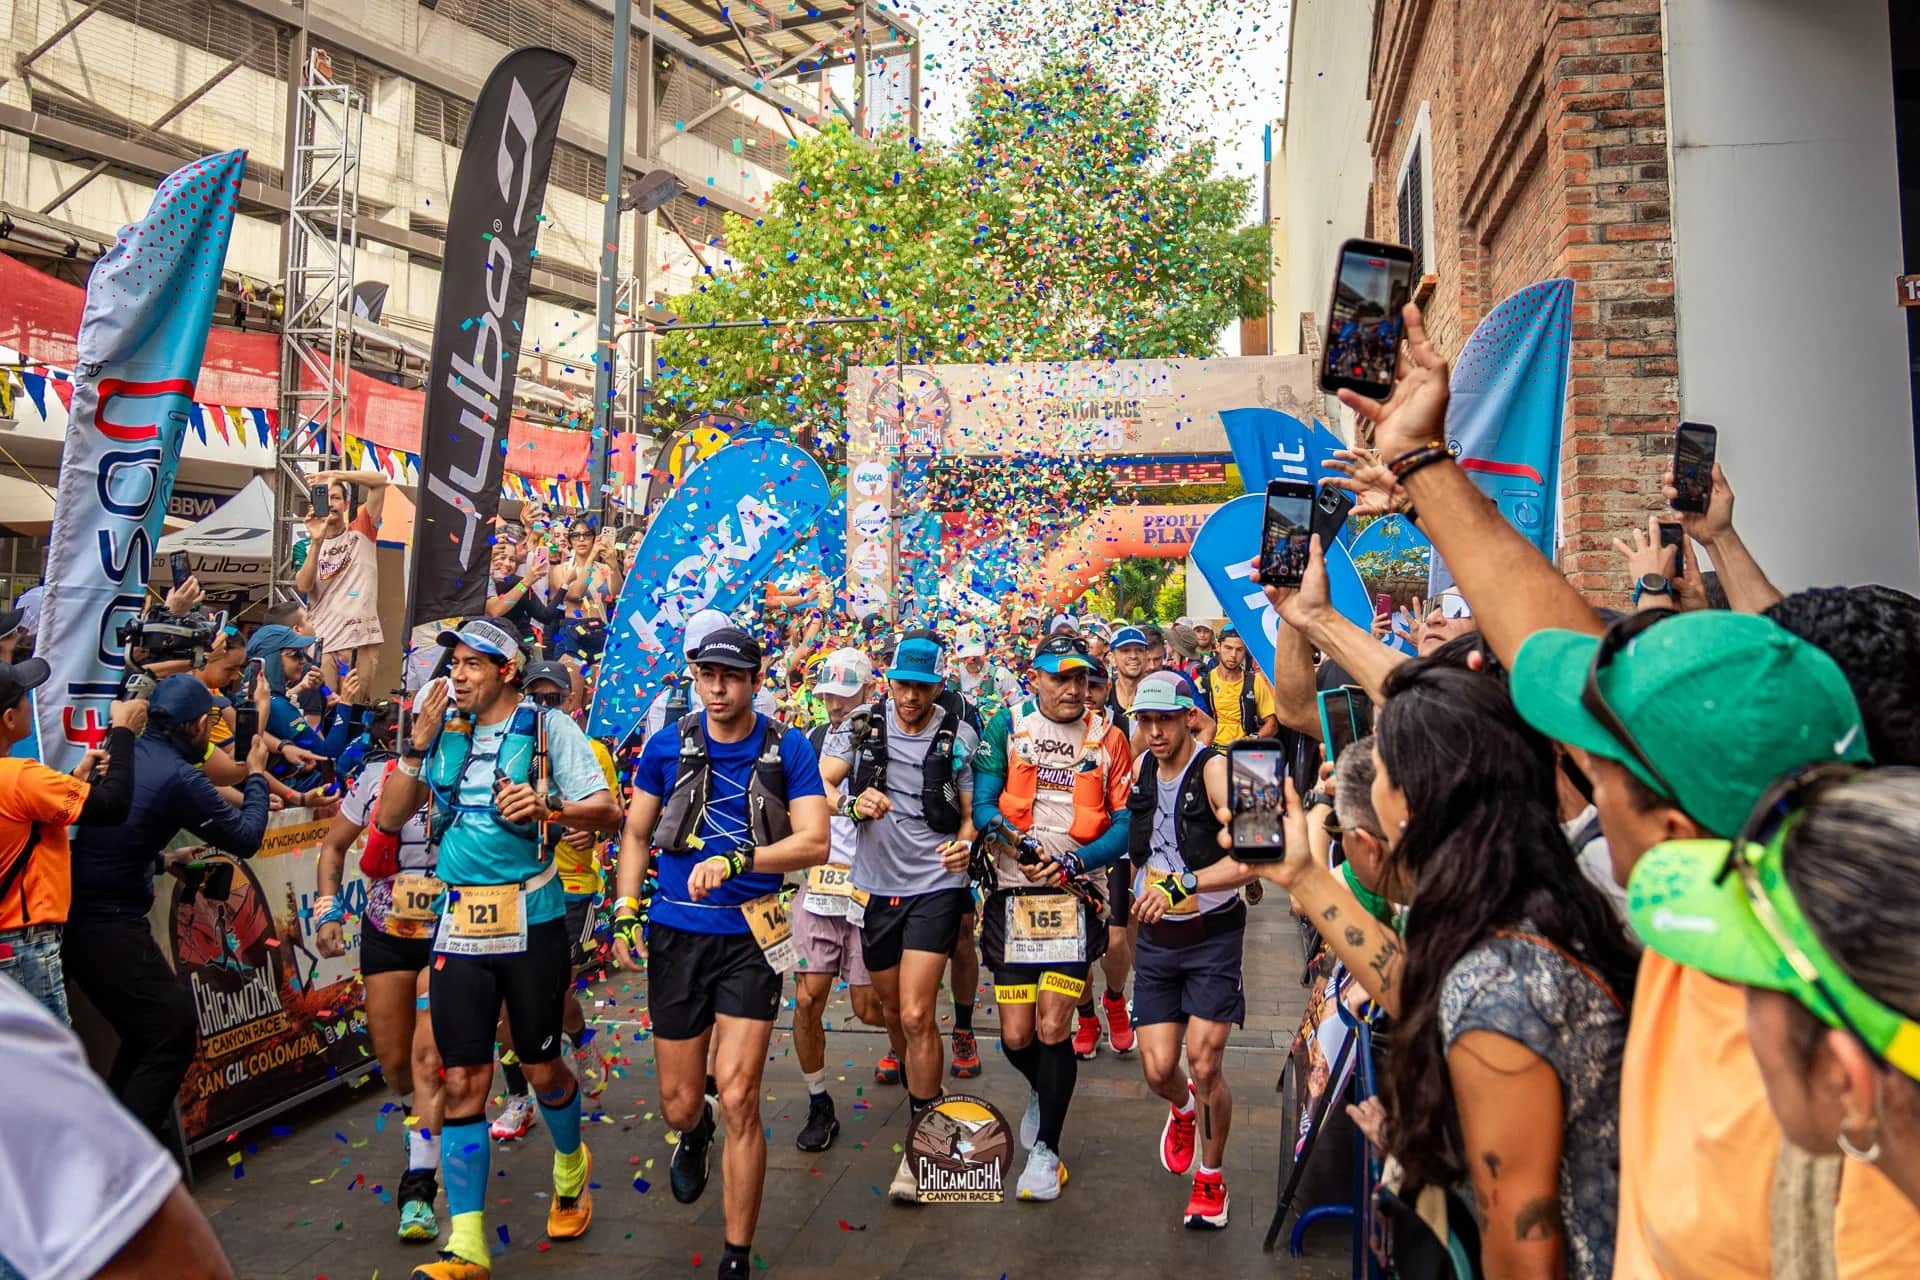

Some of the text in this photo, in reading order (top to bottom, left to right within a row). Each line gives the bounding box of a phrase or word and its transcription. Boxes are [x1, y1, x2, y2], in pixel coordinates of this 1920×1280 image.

[428, 237, 512, 573] Julbo
[857, 472, 884, 485] HOKA
[169, 497, 217, 516] BBVA
[192, 556, 260, 573] Julbo
[627, 494, 790, 654] HOKA
[704, 642, 741, 654] SALOMON
[1034, 739, 1075, 758] HOKA
[818, 869, 850, 886] 183
[299, 879, 369, 936] HKA
[467, 904, 498, 924] 121
[1028, 910, 1063, 928] 165
[190, 951, 283, 1037] CHICAMOCHA
[211, 1017, 282, 1052] CANYON RACE
[197, 1031, 321, 1098] SAN GIL COLOMBIA
